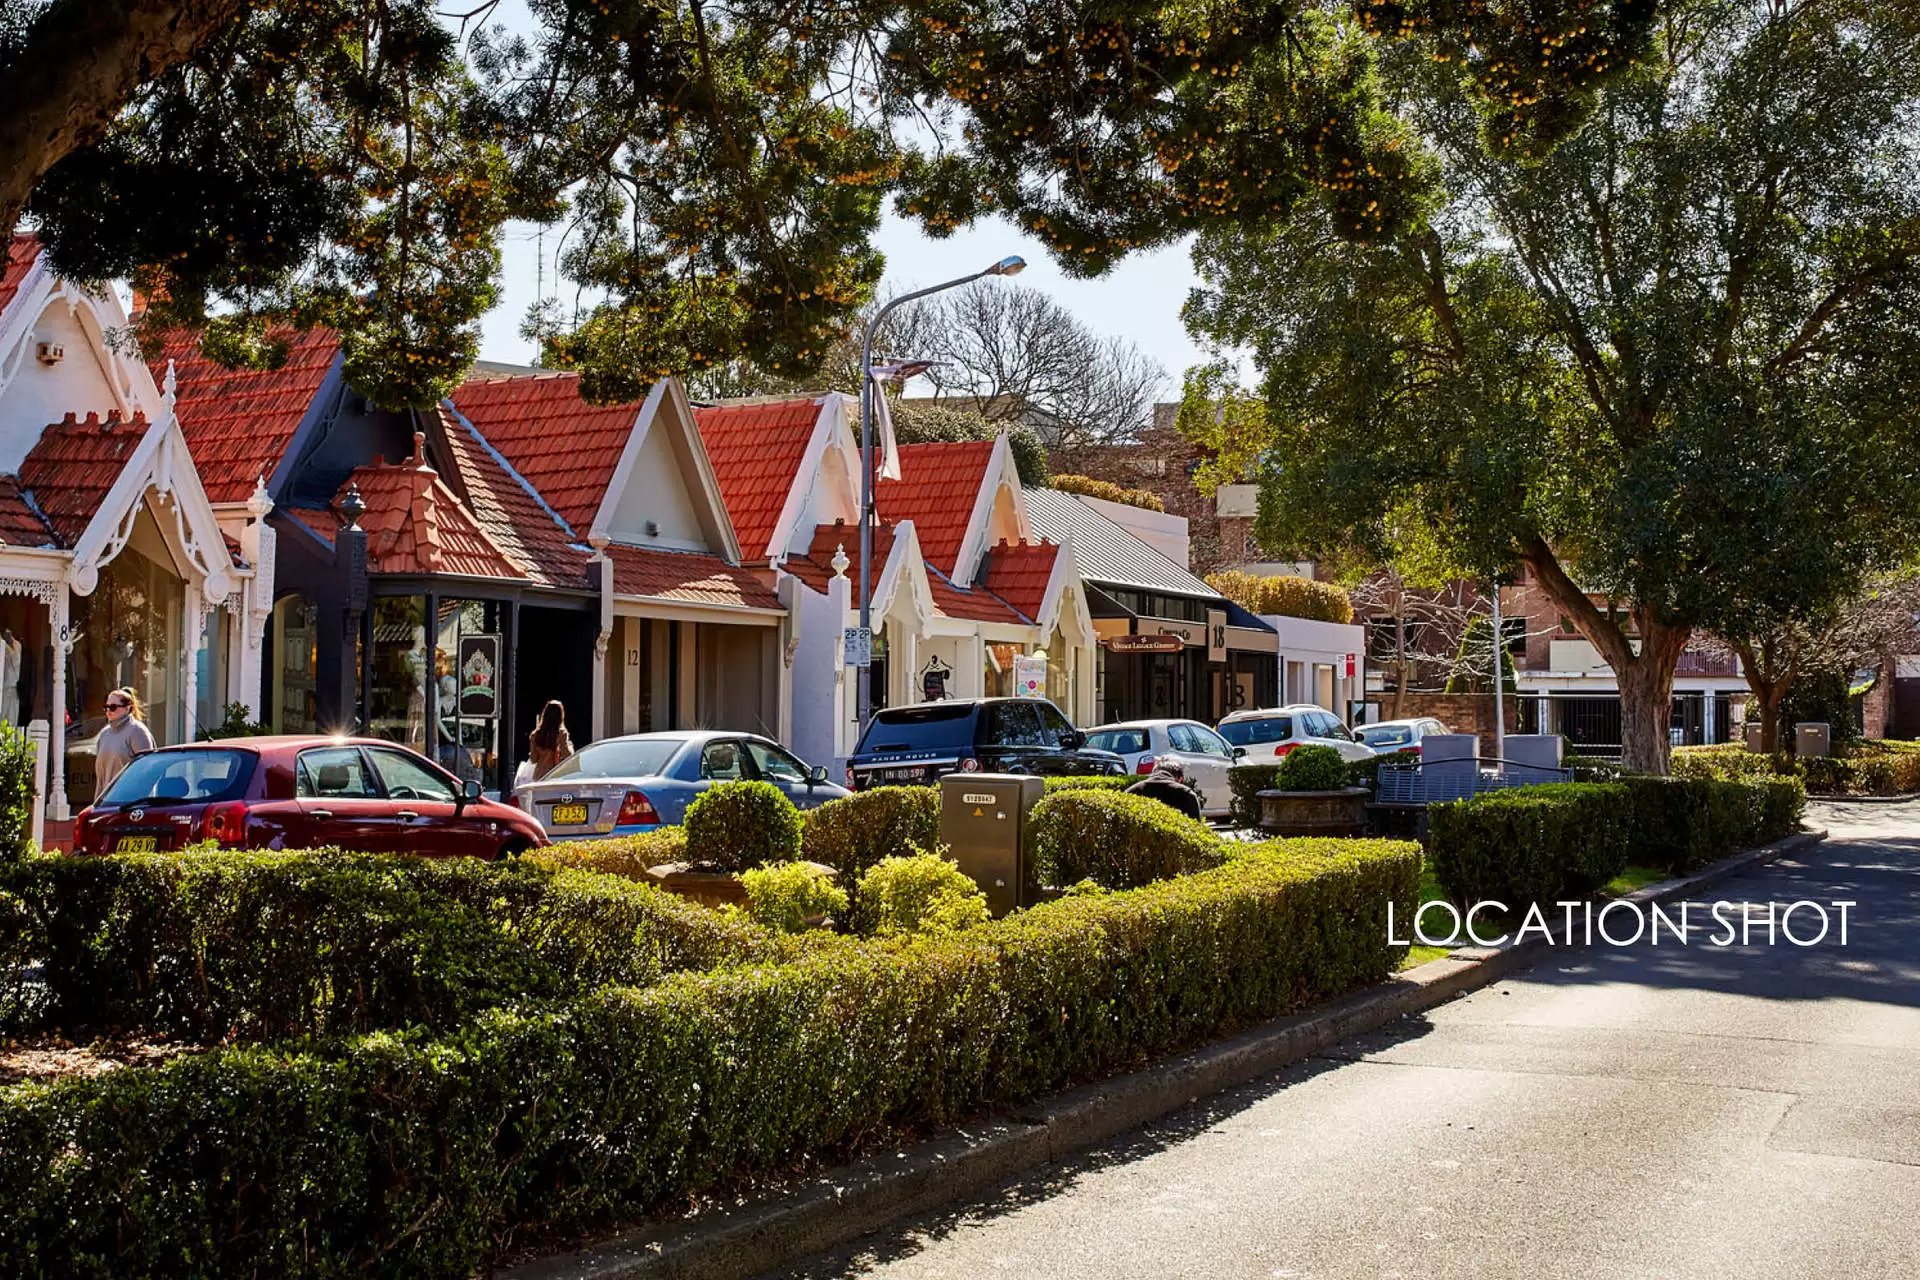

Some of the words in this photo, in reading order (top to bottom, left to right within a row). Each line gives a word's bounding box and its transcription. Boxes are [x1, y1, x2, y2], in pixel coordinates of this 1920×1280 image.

[60, 625, 68, 641] 8
[845, 630, 857, 640] 2P
[859, 630, 870, 640] 2P
[1213, 624, 1225, 648] 18
[627, 649, 639, 666] 12
